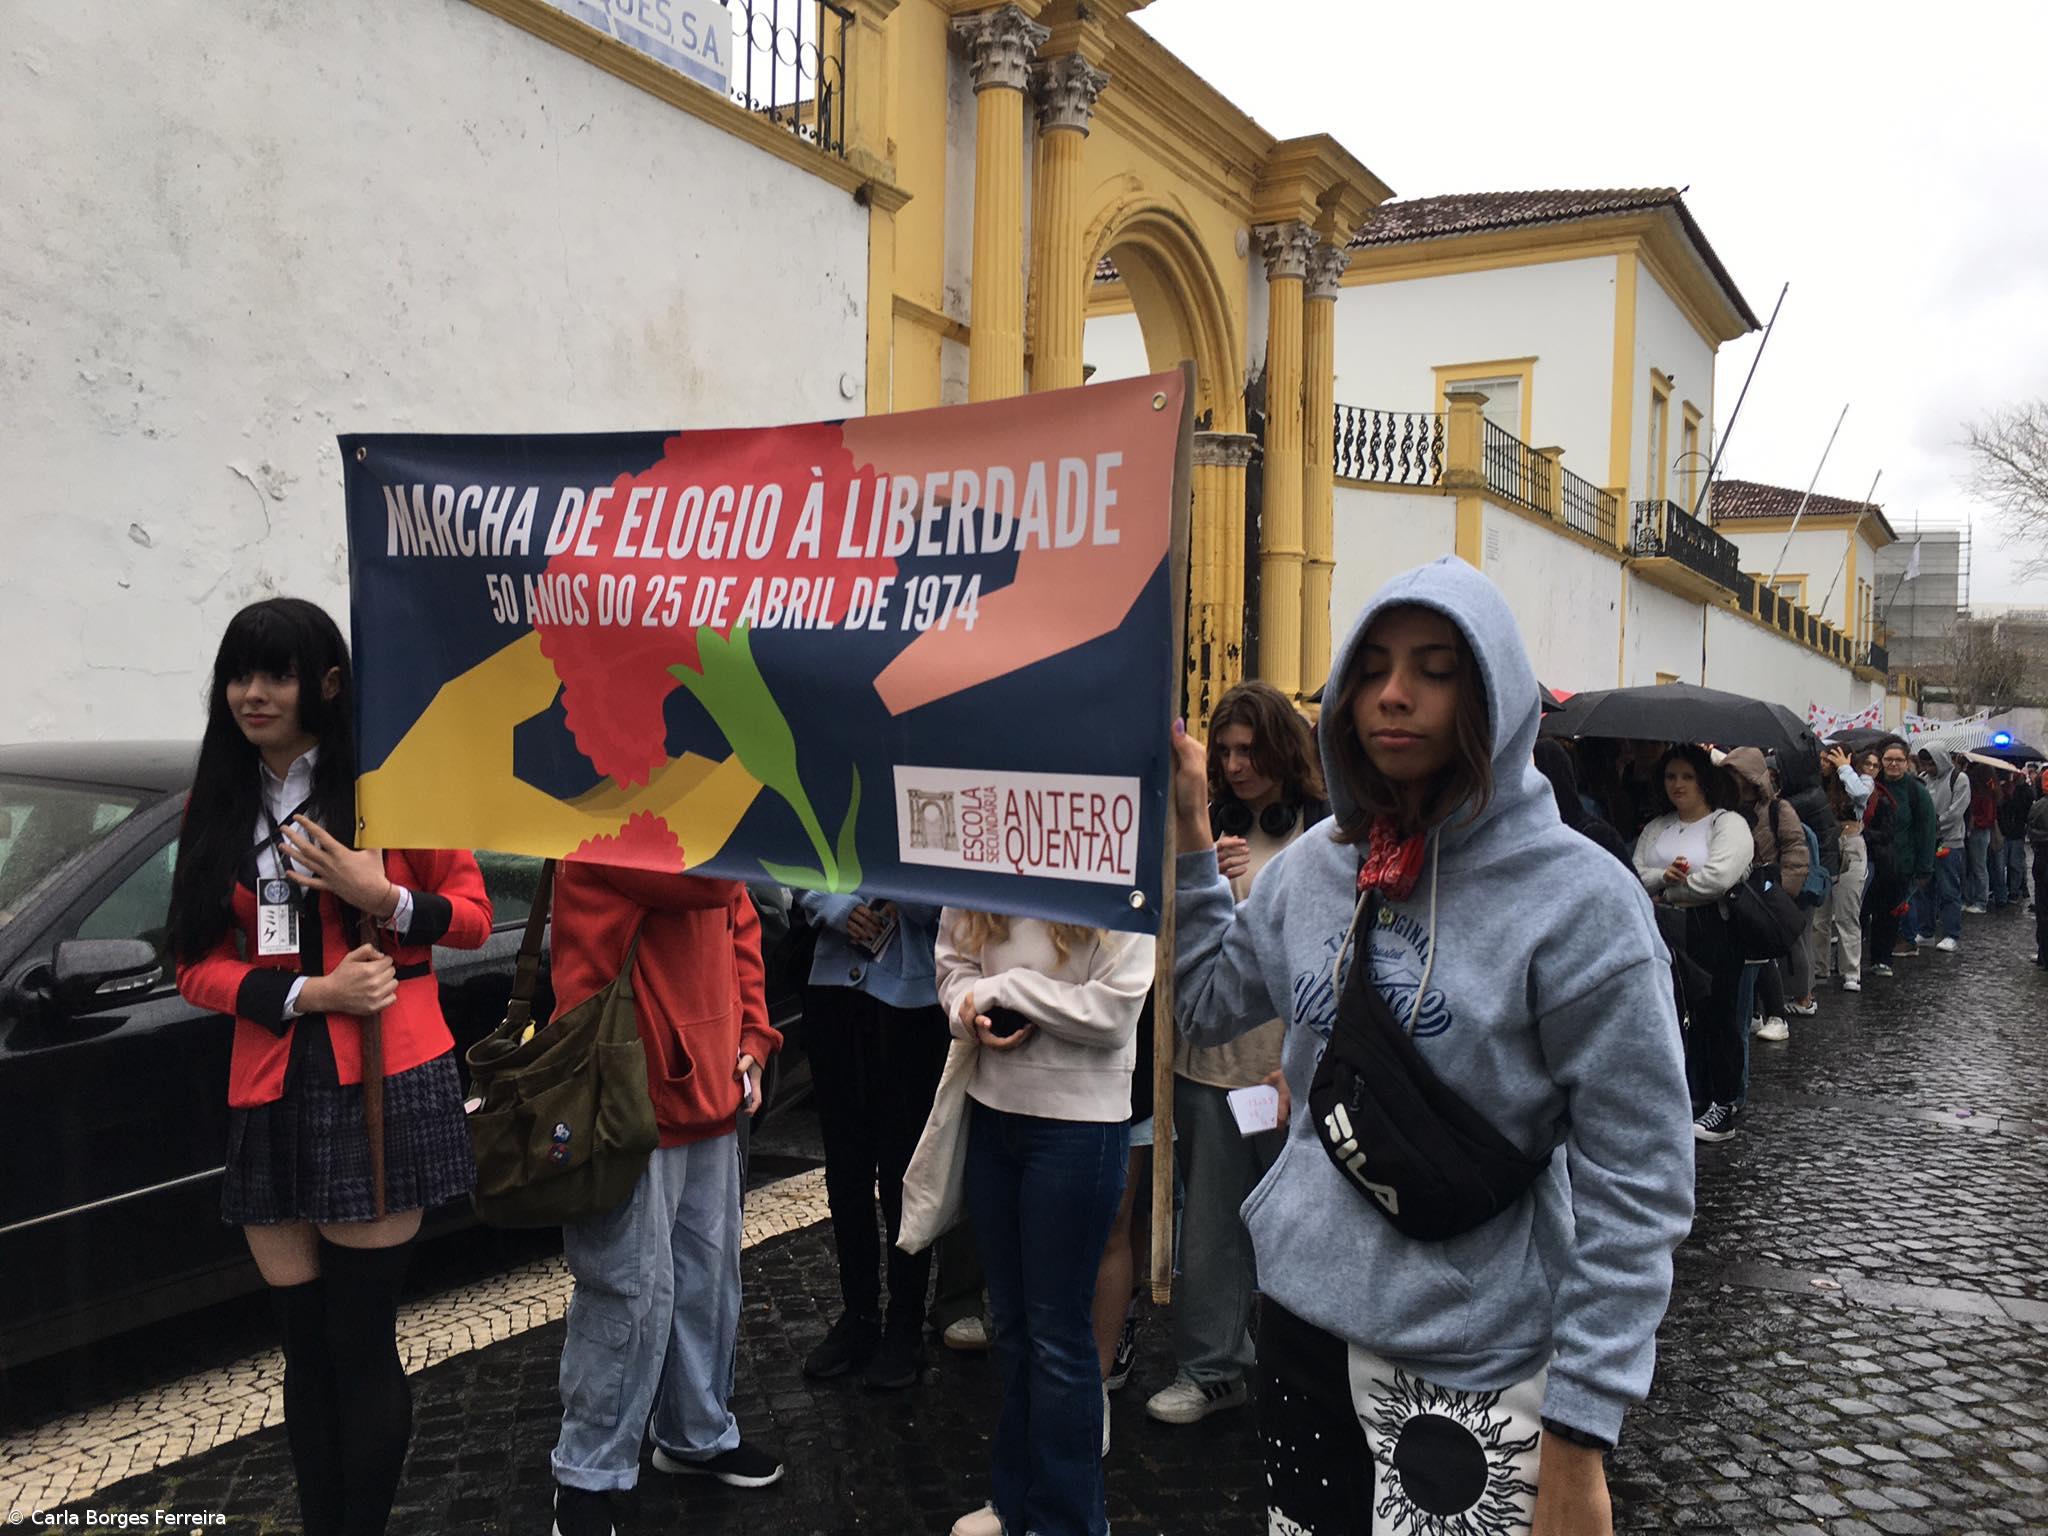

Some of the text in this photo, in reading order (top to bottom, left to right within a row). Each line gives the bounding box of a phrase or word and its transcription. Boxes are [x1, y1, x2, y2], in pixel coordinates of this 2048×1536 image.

[682, 11, 724, 66] S.A.
[383, 452, 1123, 559] MARCHA DE ELOGIO À LIBERDADE
[486, 574, 982, 631] 50 ANOS DO 25 DE ABRIL DE 1974
[961, 787, 985, 863] ESCOLA
[984, 785, 1000, 864] SECUNDÁRIA
[1004, 789, 1133, 835] ANTERO
[1005, 826, 1131, 876] QUENTAL
[1324, 1102, 1399, 1215] FILA
